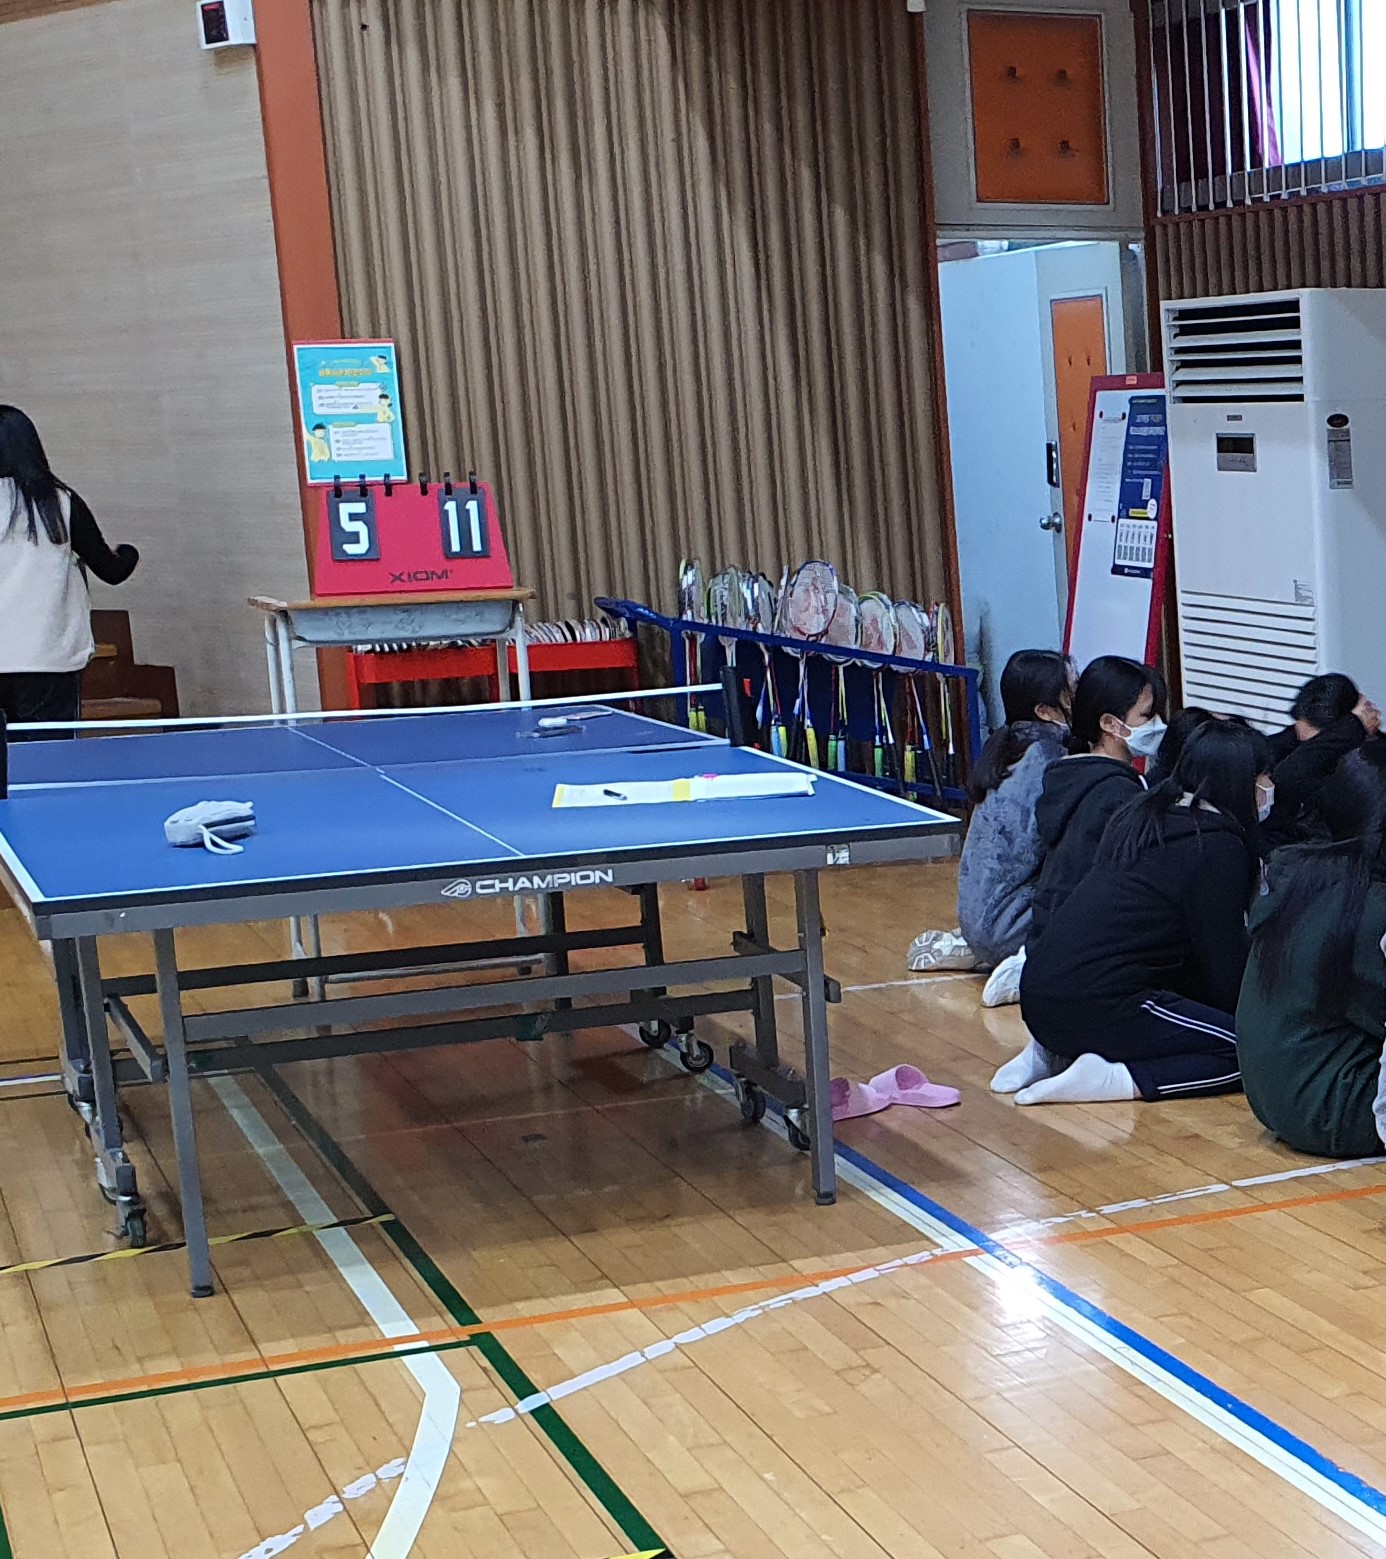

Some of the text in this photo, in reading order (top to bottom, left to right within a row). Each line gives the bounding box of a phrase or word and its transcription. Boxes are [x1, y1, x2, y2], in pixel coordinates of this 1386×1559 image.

[338, 502, 370, 555] 5
[443, 499, 483, 553] 11
[389, 568, 450, 584] XIOM
[475, 868, 614, 895] CHAMPION
